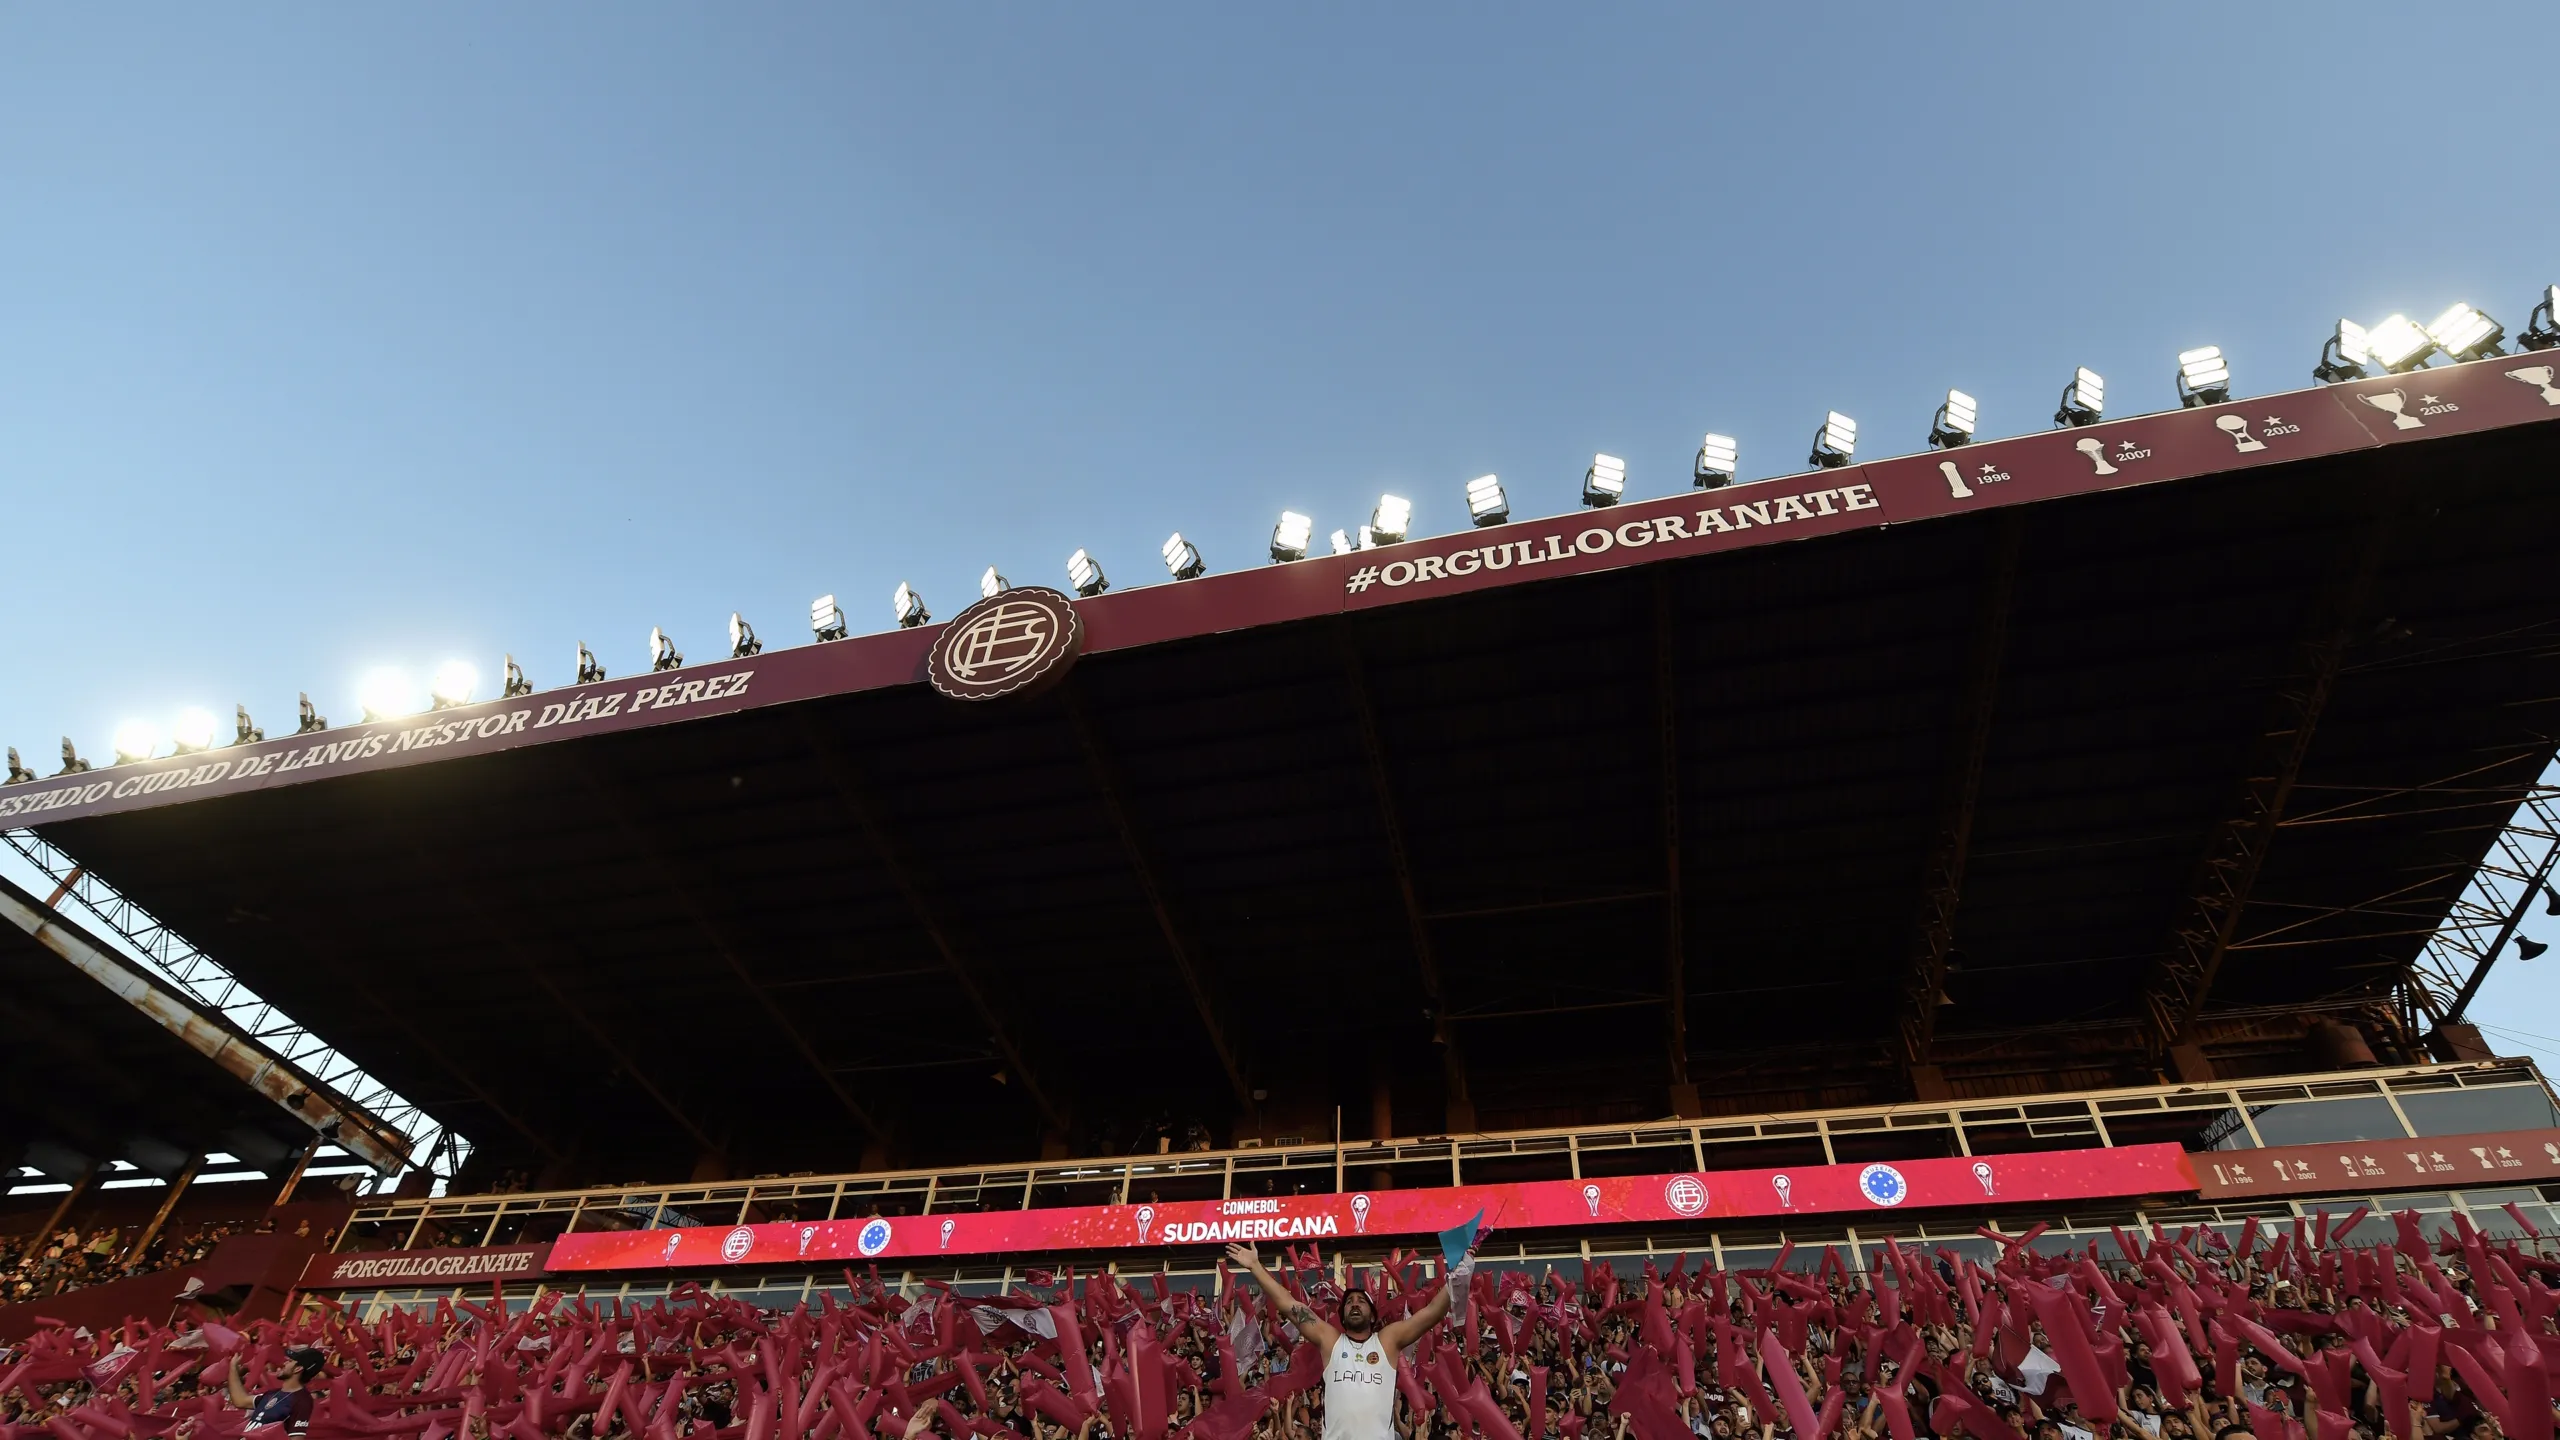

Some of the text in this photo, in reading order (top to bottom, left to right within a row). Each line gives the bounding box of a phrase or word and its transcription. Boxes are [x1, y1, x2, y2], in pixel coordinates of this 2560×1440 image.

[2419, 403, 2460, 416] 2016
[2263, 424, 2301, 437] 2013
[2116, 448, 2151, 462] 2007
[1976, 472, 2011, 485] 1996
[1345, 483, 1880, 594] #ORGULLOGRANATE
[0, 670, 755, 818] ESTADIO CIUDAD DE LANÚS NÉSTOR DÍAZ PÉREZ
[2433, 1163, 2455, 1172] 2016
[2500, 1159, 2523, 1168] 2016
[1862, 1166, 1898, 1179] CRUZEIRO
[2364, 1168, 2385, 1176] 2013
[1162, 1215, 1339, 1243] SUDAMERICANA
[331, 1251, 534, 1279] #ORGULLOGRANATE
[1333, 1370, 1383, 1385] LANUS
